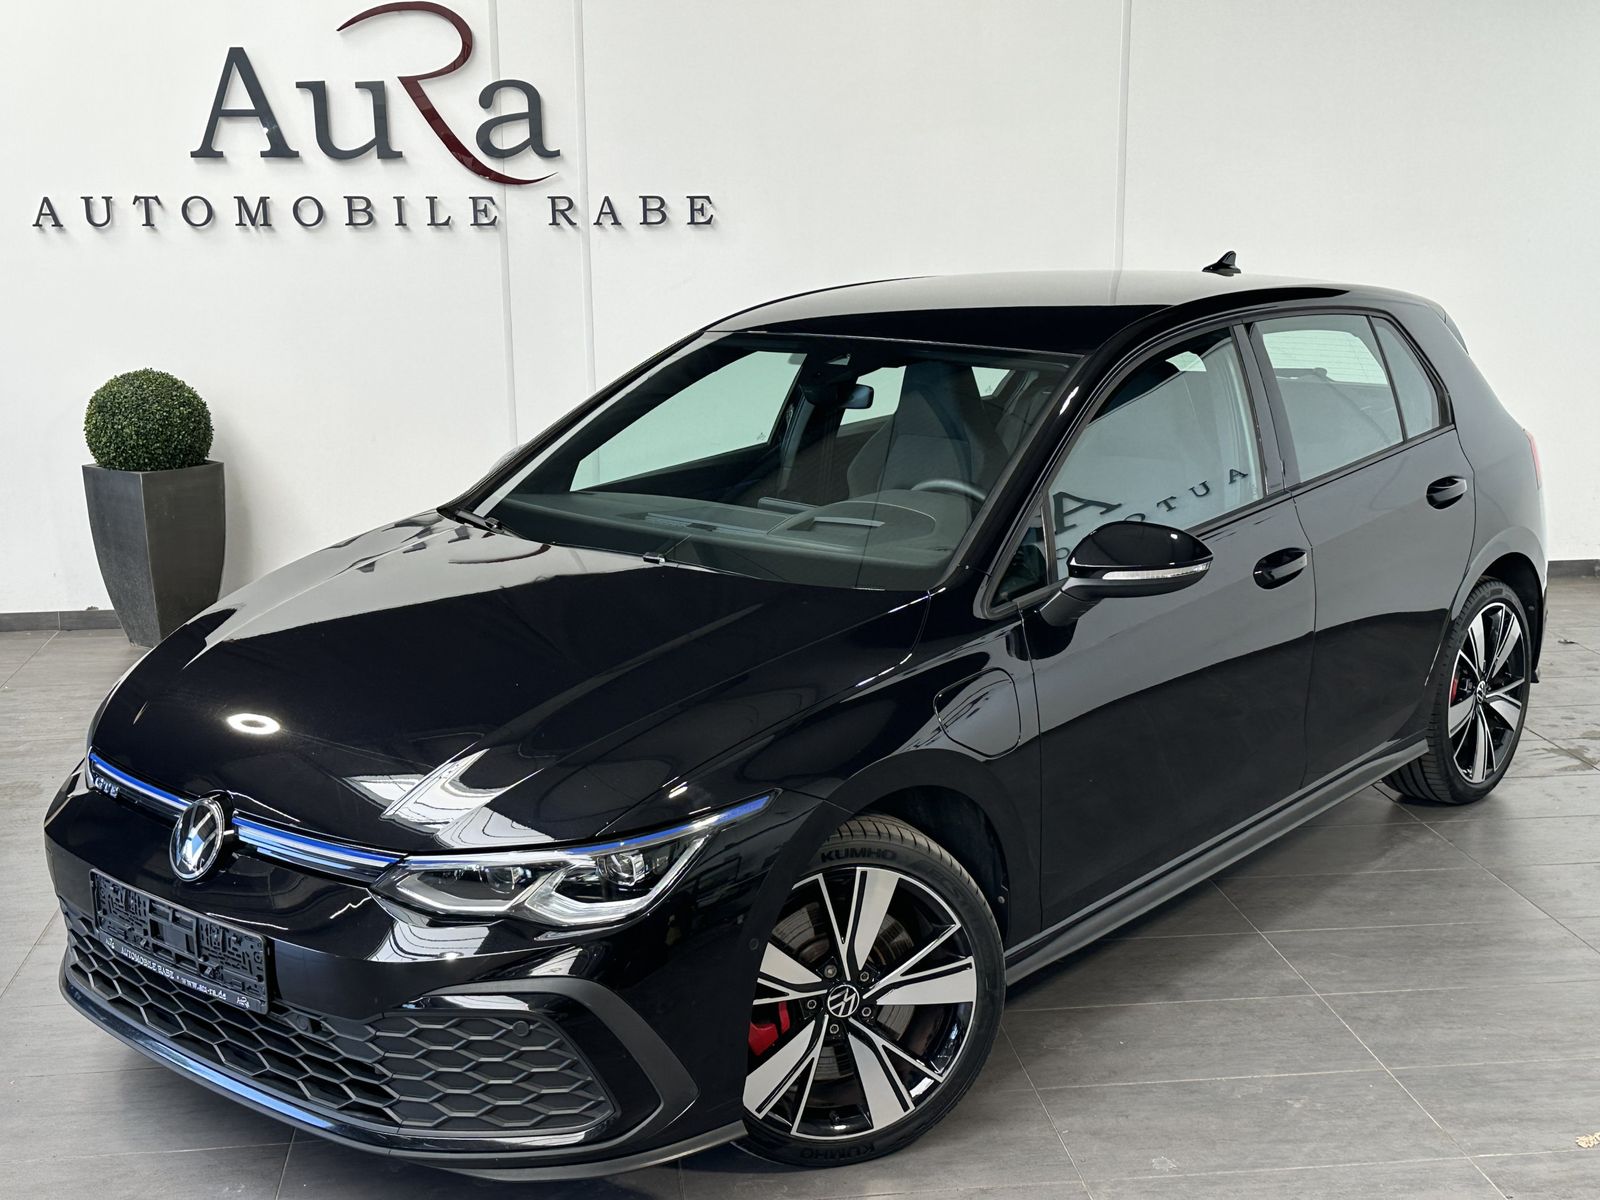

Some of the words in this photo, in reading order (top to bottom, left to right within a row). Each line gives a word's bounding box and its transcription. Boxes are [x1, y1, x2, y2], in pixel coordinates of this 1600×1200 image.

[33, 195, 499, 228] AUTOMOBILE
[549, 195, 716, 228] RABE
[94, 776, 120, 799] GTE
[820, 847, 899, 864] KUMHO
